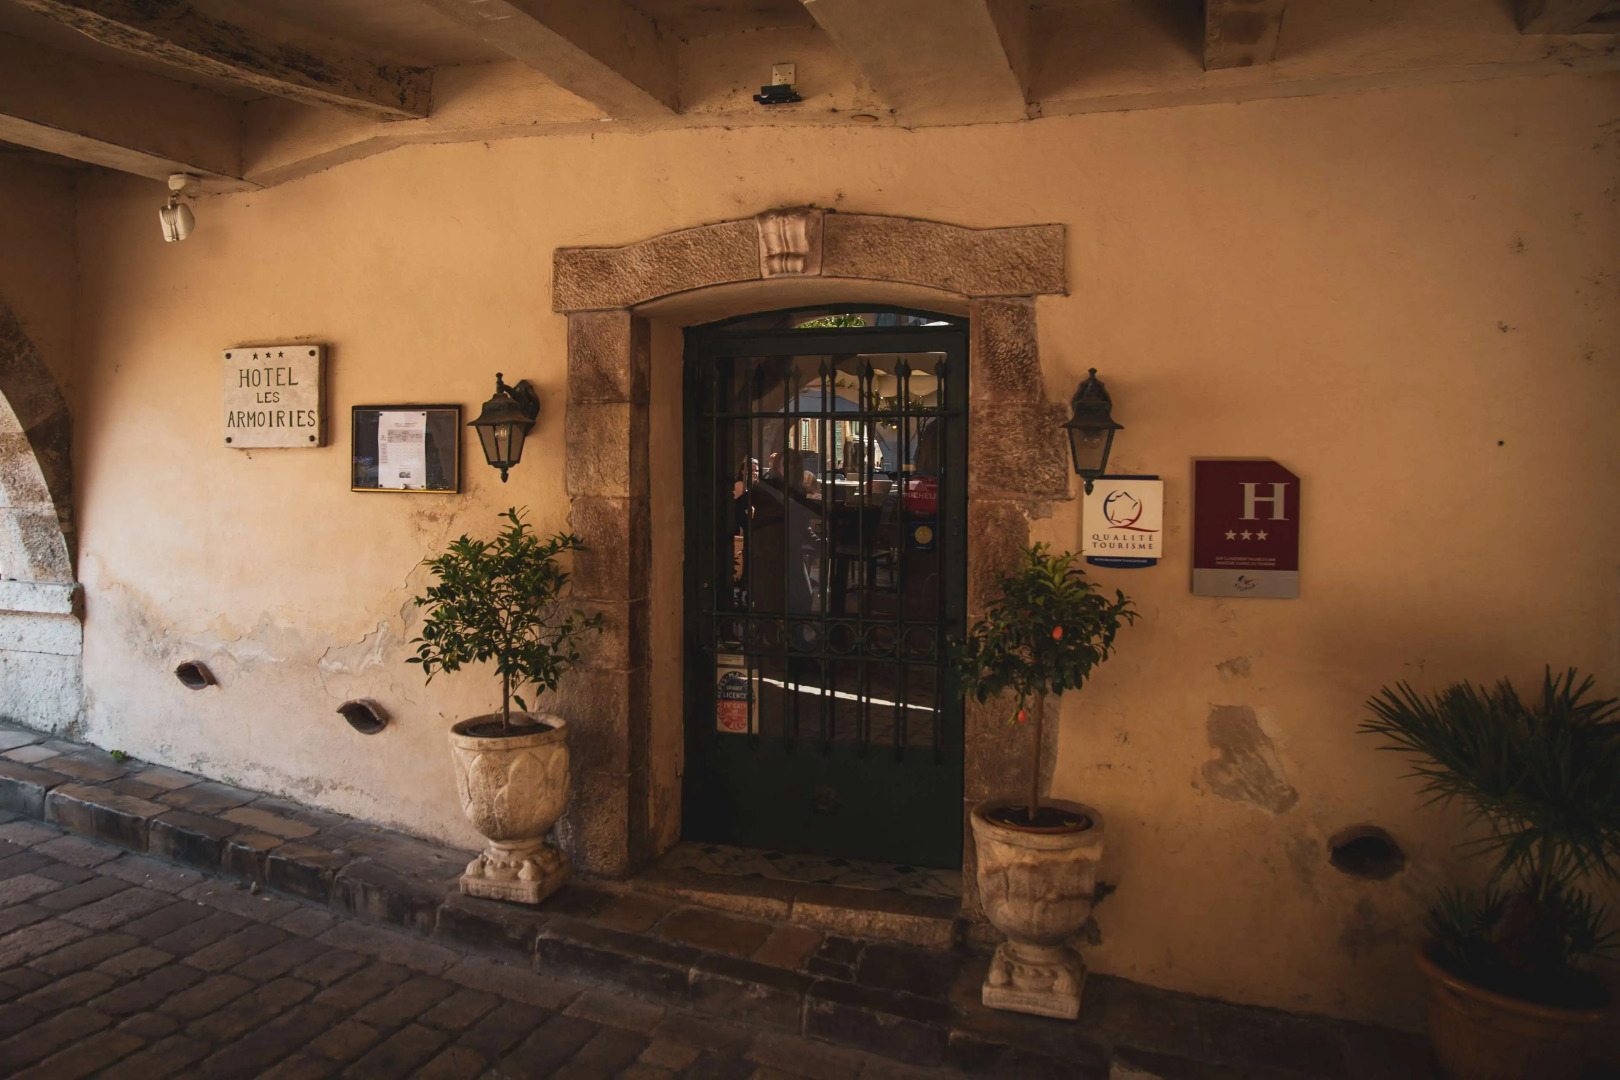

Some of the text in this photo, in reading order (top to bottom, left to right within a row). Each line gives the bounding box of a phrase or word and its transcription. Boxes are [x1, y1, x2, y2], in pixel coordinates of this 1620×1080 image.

[238, 366, 299, 388] HOTEL
[256, 391, 280, 404] LES
[227, 409, 316, 428] ARMOIRIES
[903, 491, 937, 500] MICHELI
[1238, 482, 1291, 521] H
[1092, 533, 1154, 542] QUALITÉ
[1092, 542, 1154, 550] TOURISME
